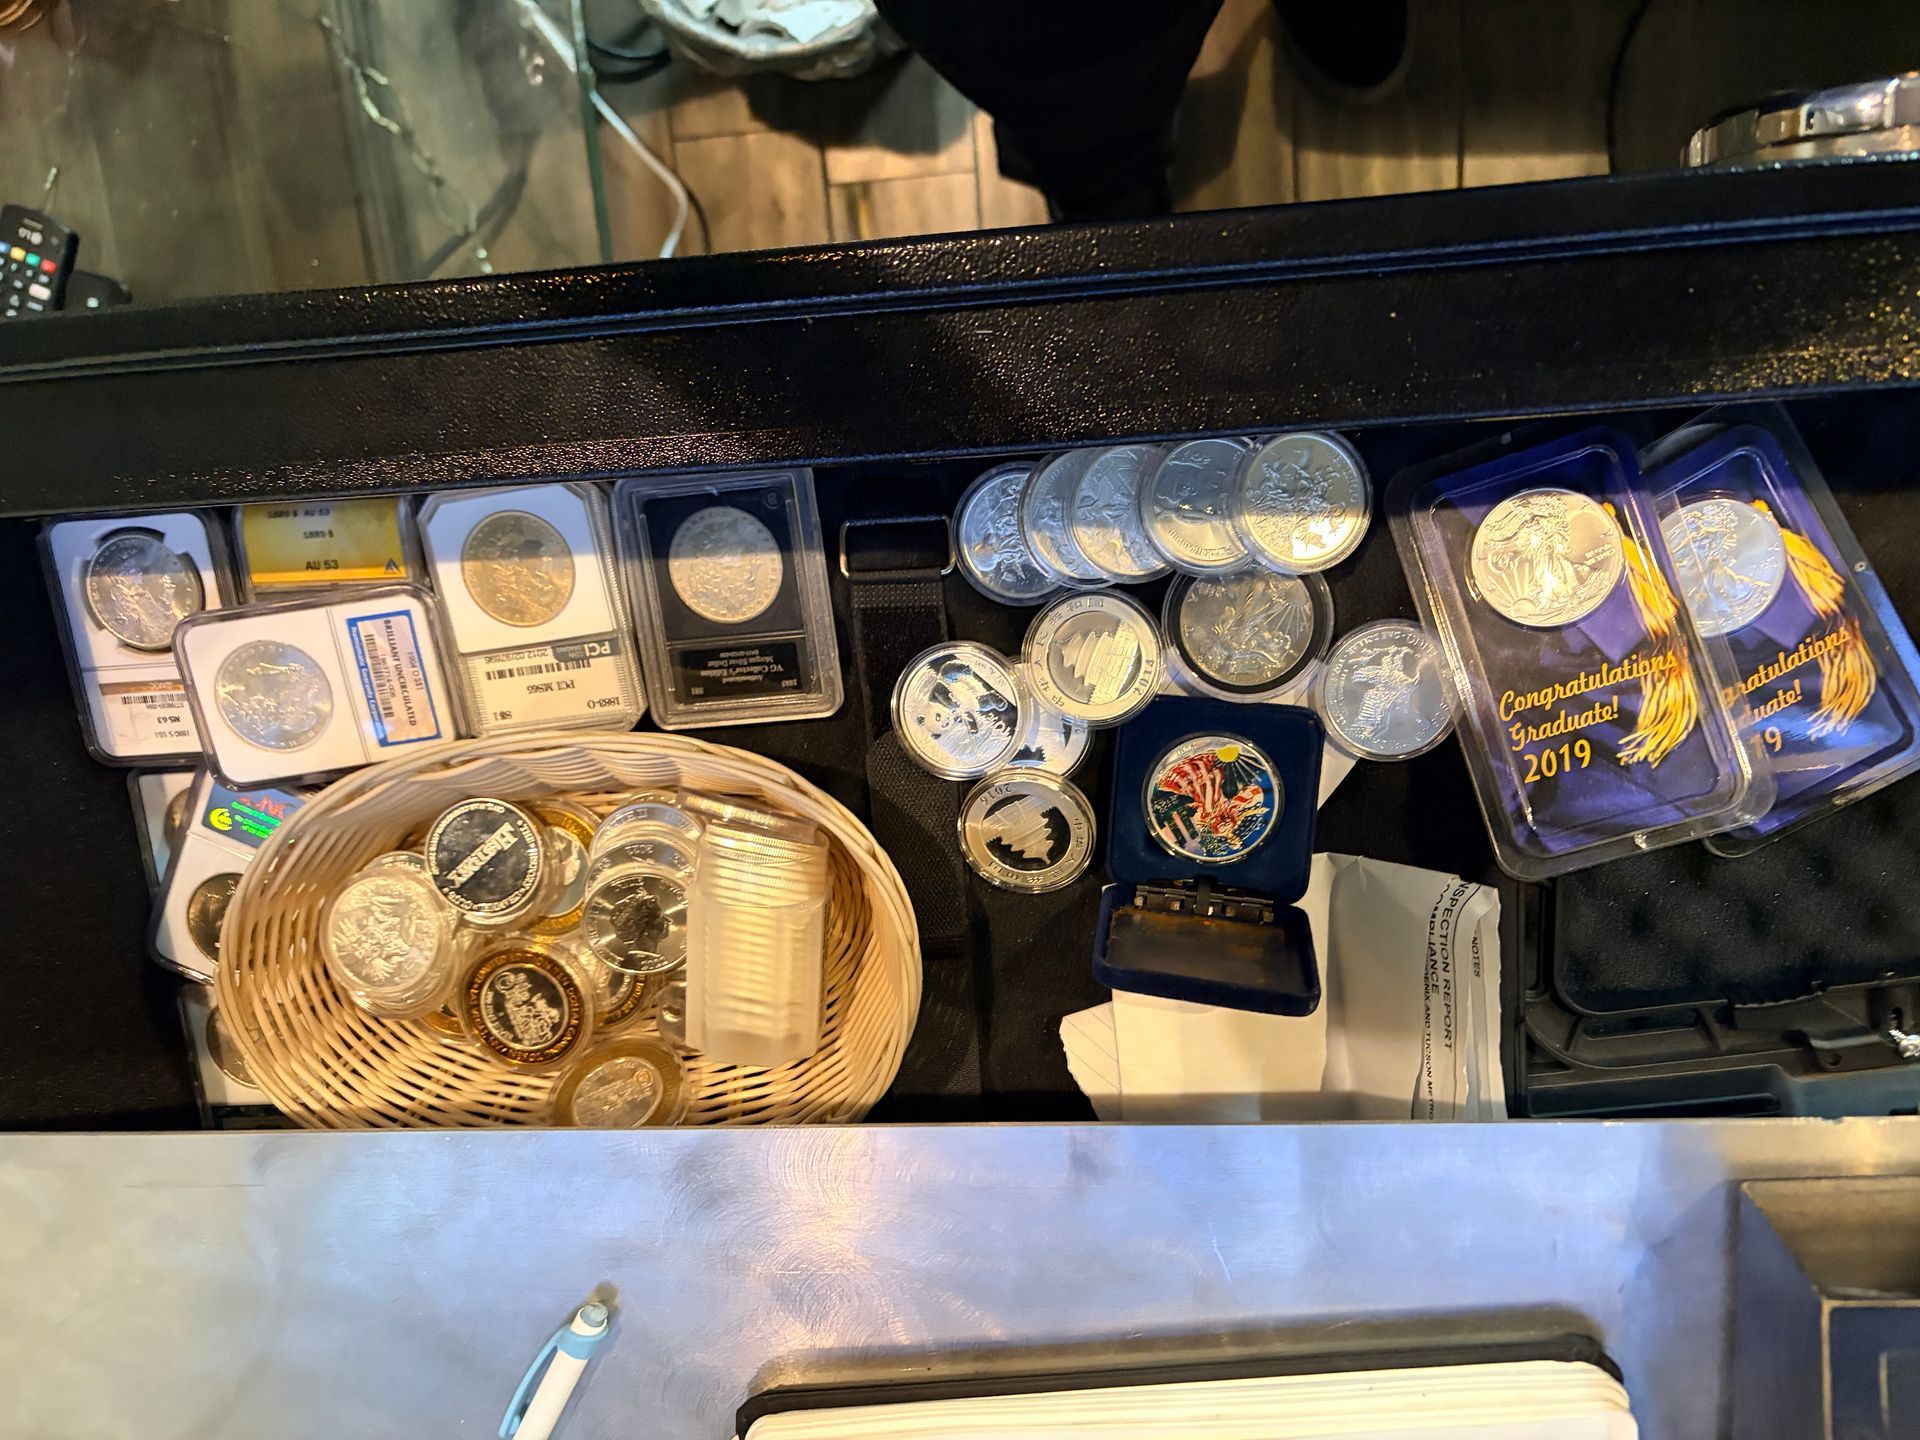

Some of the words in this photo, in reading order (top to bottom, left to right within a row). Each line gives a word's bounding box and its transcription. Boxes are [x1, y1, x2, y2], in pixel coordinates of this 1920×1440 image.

[305, 560, 321, 570] AU
[324, 560, 339, 569] 53
[584, 640, 611, 657] PCI
[707, 659, 728, 668] Dollar
[729, 658, 747, 666] Silver
[383, 619, 400, 662] BRILLIANT
[395, 663, 417, 727] UNCIRCULATED
[700, 668, 727, 679] Edition
[729, 664, 768, 676] Collector's
[770, 663, 784, 672] VG
[1132, 658, 1155, 697] 2014
[526, 682, 554, 695] MS65
[556, 679, 575, 691] PCI
[1500, 650, 1679, 722] Congratulations
[1508, 695, 1618, 751] Graduate!
[1523, 738, 1591, 784] 2019
[978, 783, 1013, 806] 2016
[447, 822, 518, 889] HISTORY
[1440, 882, 1470, 973] NSPECTION
[1472, 936, 1480, 977] NOTES
[1442, 978, 1452, 1051] REPORT
[1425, 1034, 1433, 1077] TUCSON
